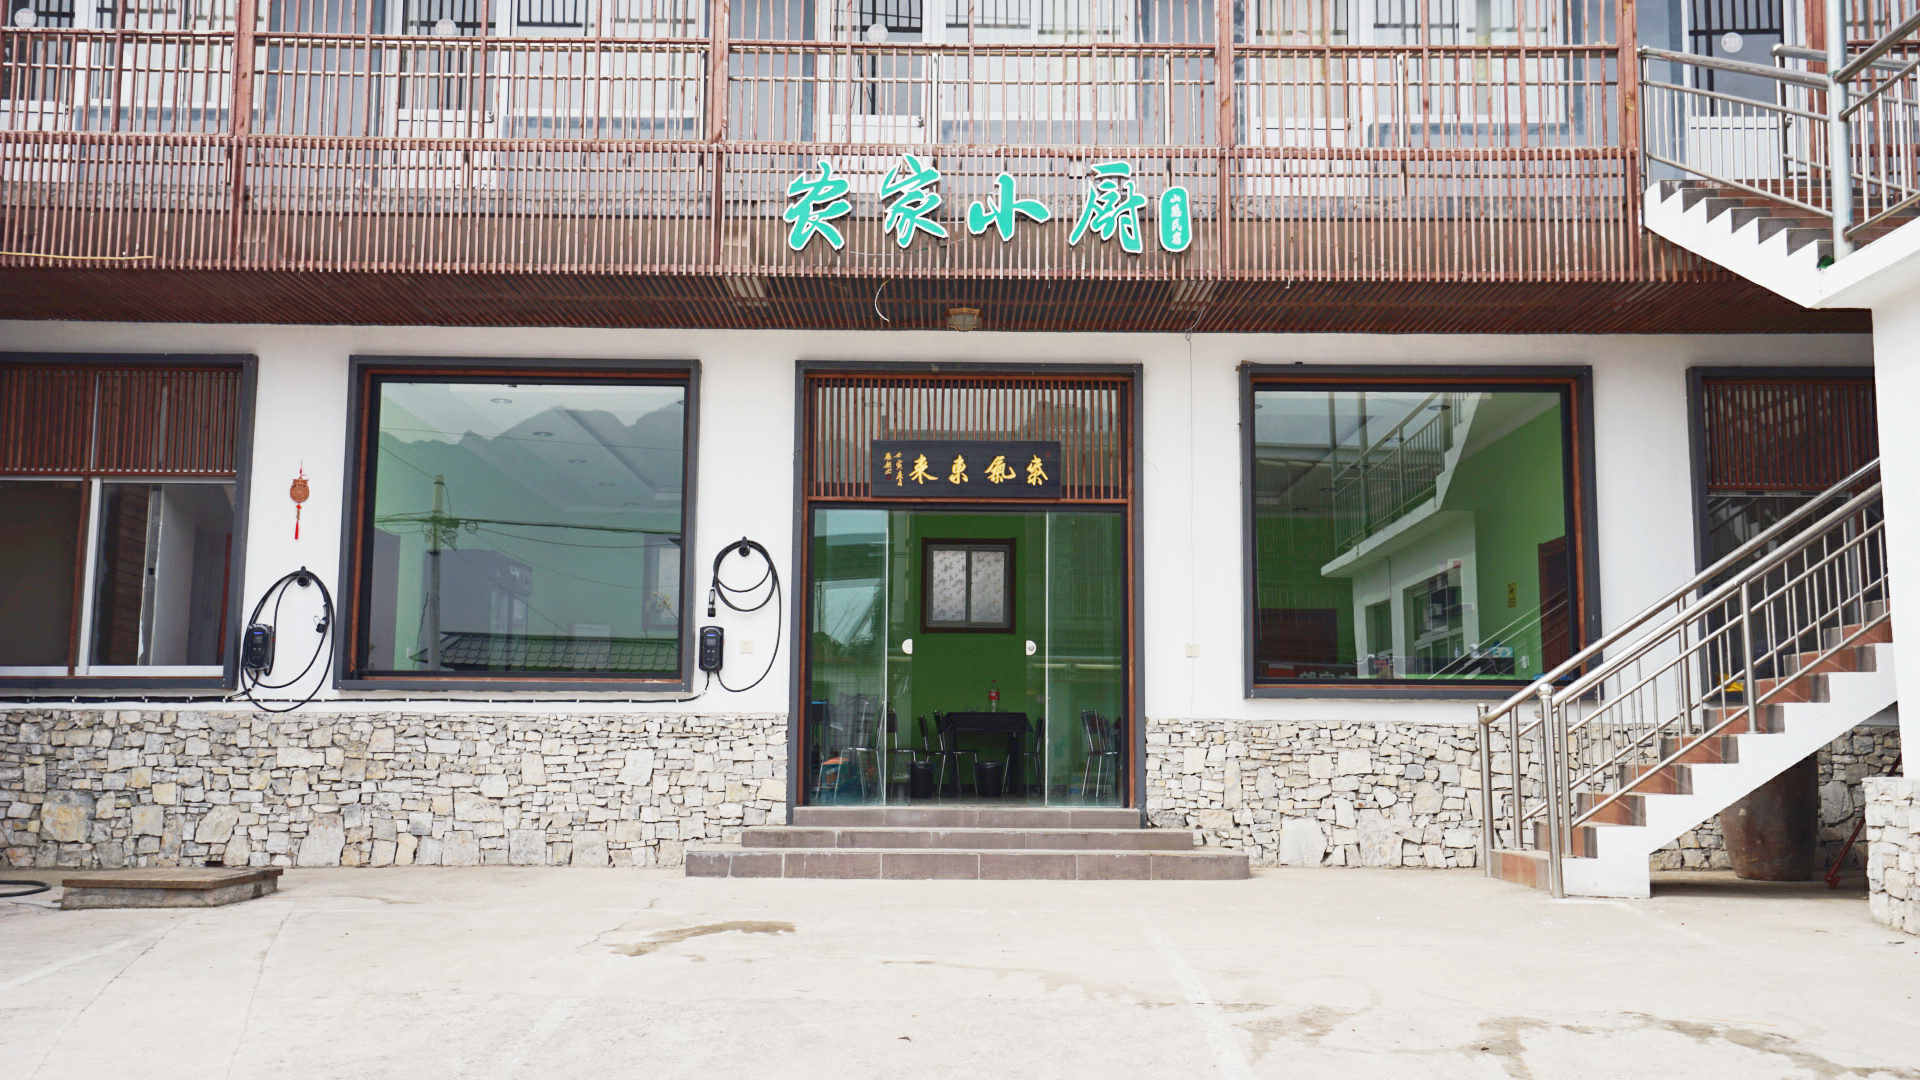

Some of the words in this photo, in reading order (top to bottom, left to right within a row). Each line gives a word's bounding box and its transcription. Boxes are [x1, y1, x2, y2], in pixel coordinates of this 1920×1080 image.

[17, 12, 34, 23] 206
[438, 23, 453, 34] 205
[1725, 38, 1739, 48] 201
[784, 154, 1147, 252] 农家小厨
